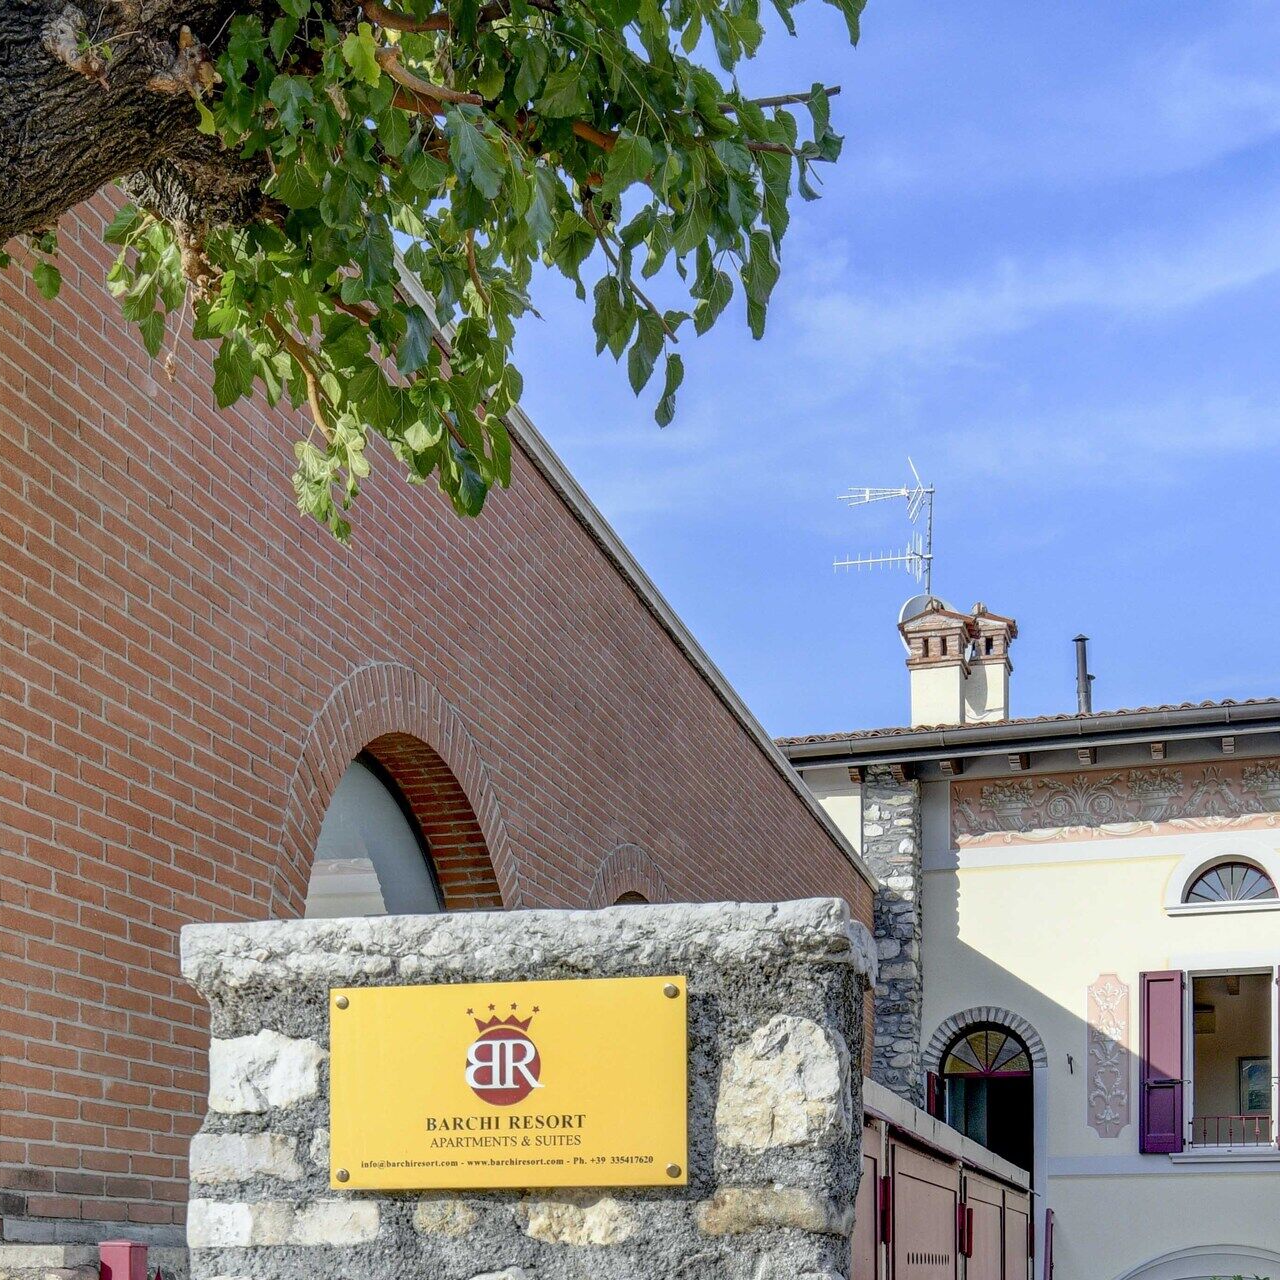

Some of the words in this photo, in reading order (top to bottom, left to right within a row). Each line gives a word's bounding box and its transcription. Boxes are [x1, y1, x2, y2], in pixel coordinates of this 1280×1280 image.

[426, 1116, 500, 1132] BARCHI
[508, 1114, 586, 1130] RESORT
[430, 1136, 517, 1148] APARTMENTS
[521, 1135, 531, 1147] &
[535, 1135, 581, 1147] SUITES
[361, 1159, 458, 1170] info@barchiresort.com
[467, 1157, 564, 1166] www.barchiresort.com
[573, 1156, 587, 1165] Ph.
[590, 1156, 606, 1164] +39
